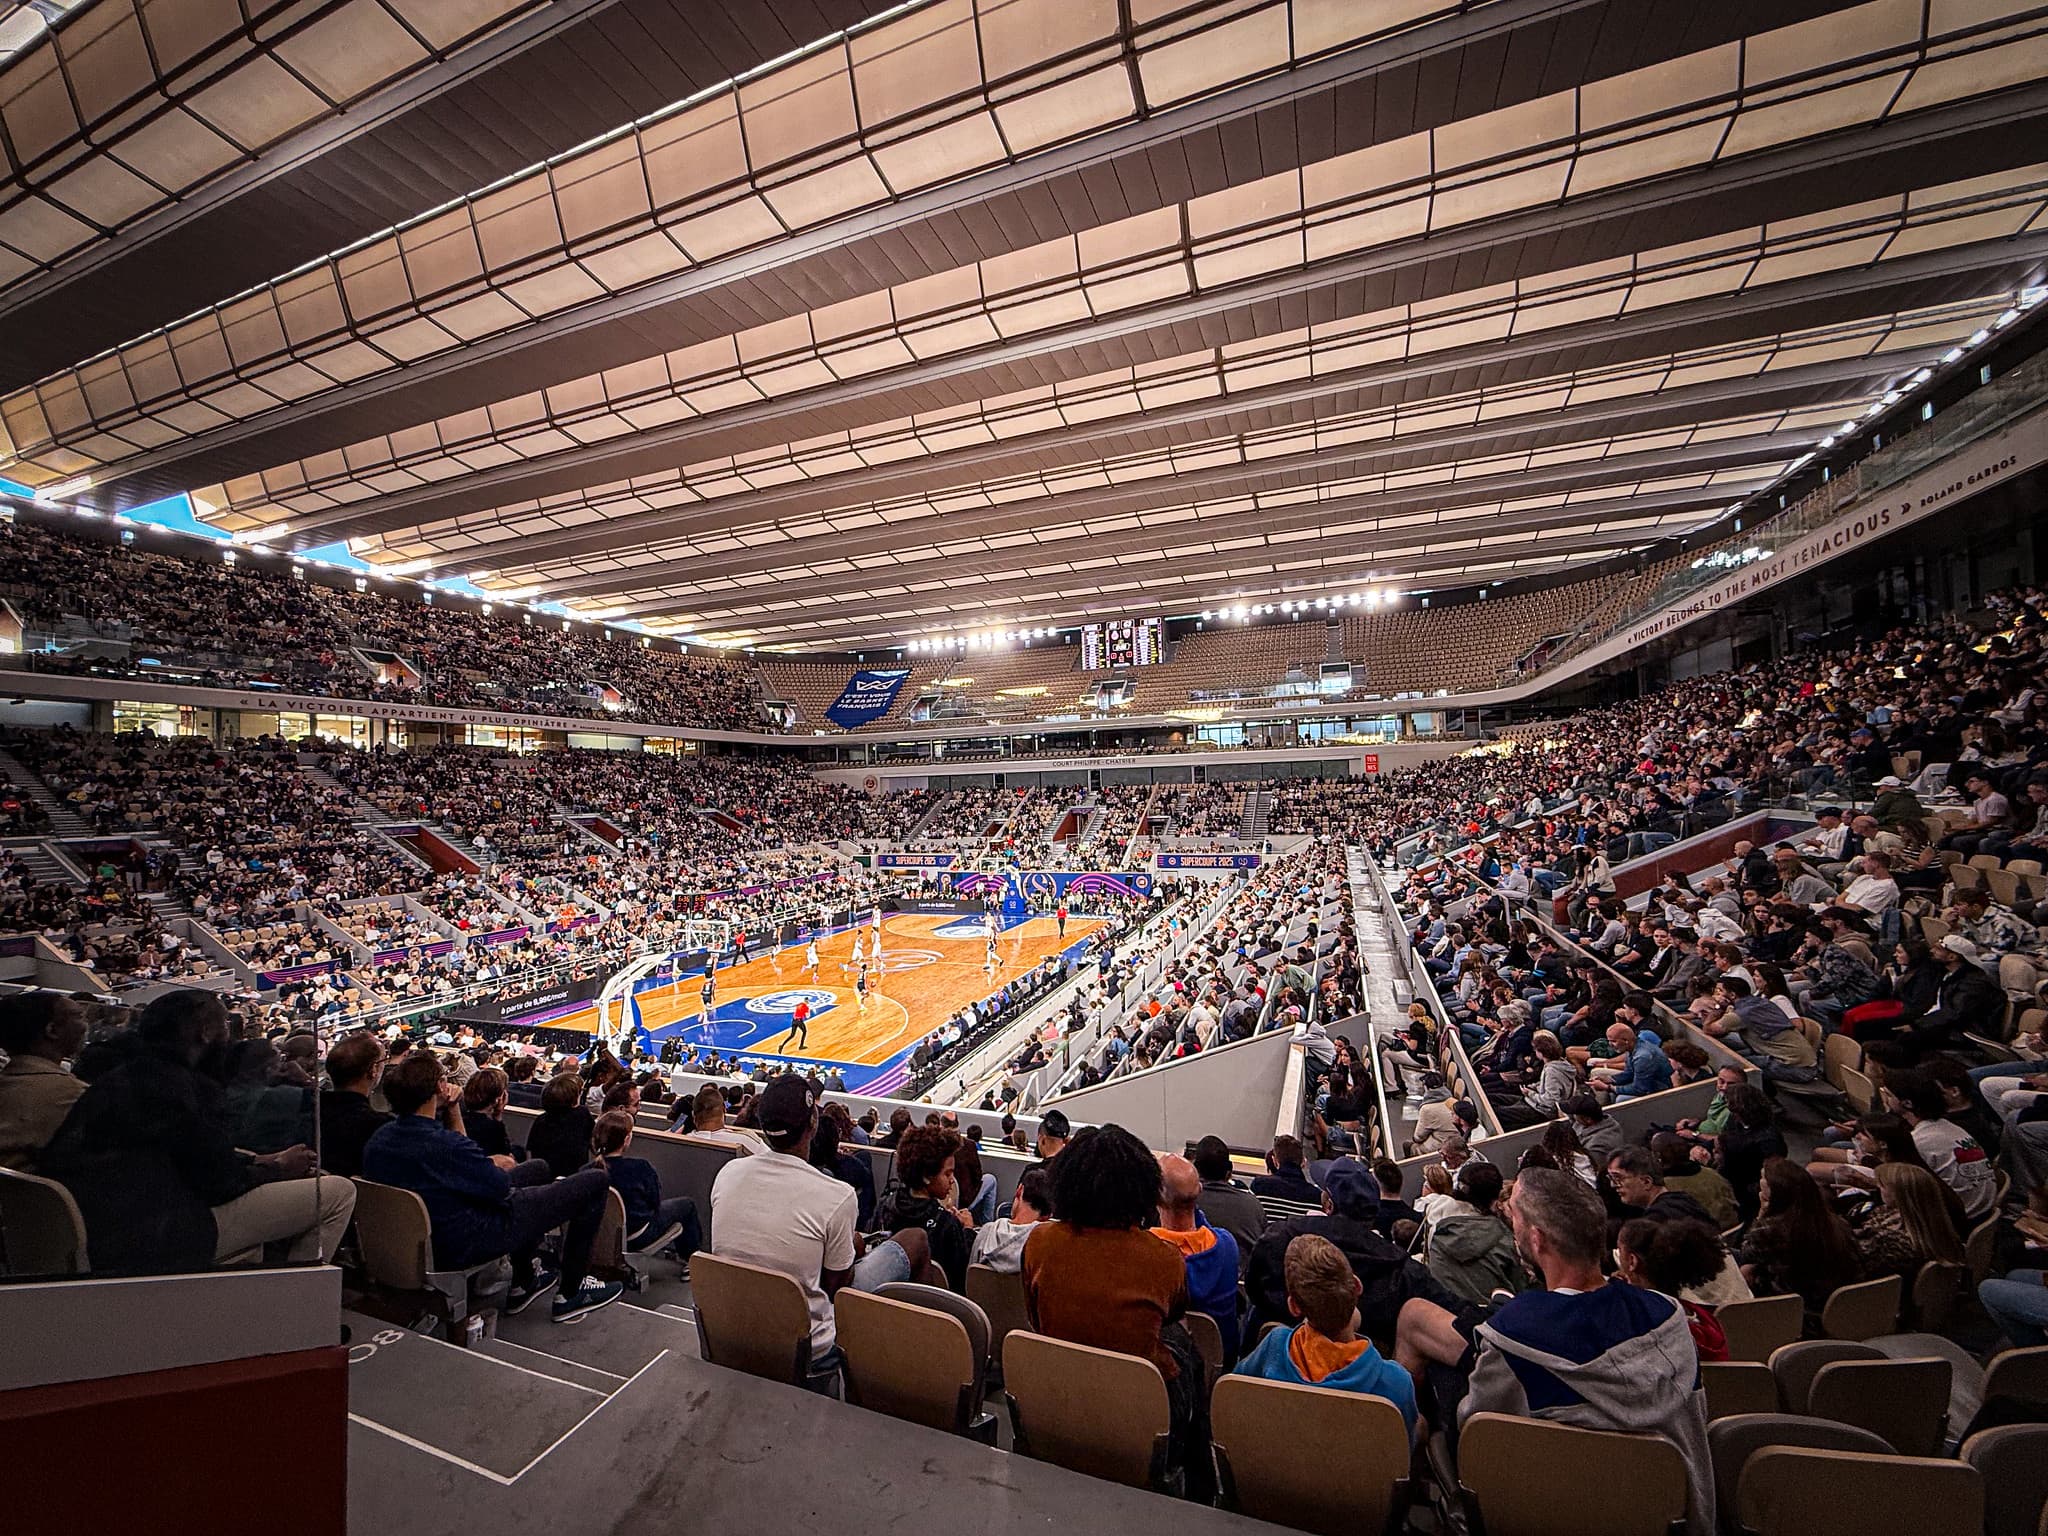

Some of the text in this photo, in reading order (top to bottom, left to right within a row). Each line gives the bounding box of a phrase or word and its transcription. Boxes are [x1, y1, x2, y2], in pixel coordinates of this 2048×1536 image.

[1920, 455, 2017, 507] ROLAND GARROS
[1633, 620, 1664, 642] VICTORY
[1666, 600, 1705, 627] BELONGS
[1708, 594, 1722, 607] TO
[1725, 581, 1747, 599] THE
[1751, 559, 1786, 586] MOST
[1792, 508, 1891, 568] TENACIOUS
[258, 698, 278, 708] LA
[286, 701, 364, 714] VICTOIRE
[371, 707, 455, 720] APPARTIENT
[460, 713, 481, 723] AU
[481, 715, 508, 725] PLUS
[513, 716, 568, 729] OPINIÂTRE
[1180, 856, 1234, 867] SUPERCOUPE 2025
[506, 1002, 524, 1015] partir
[524, 1000, 533, 1009] de
